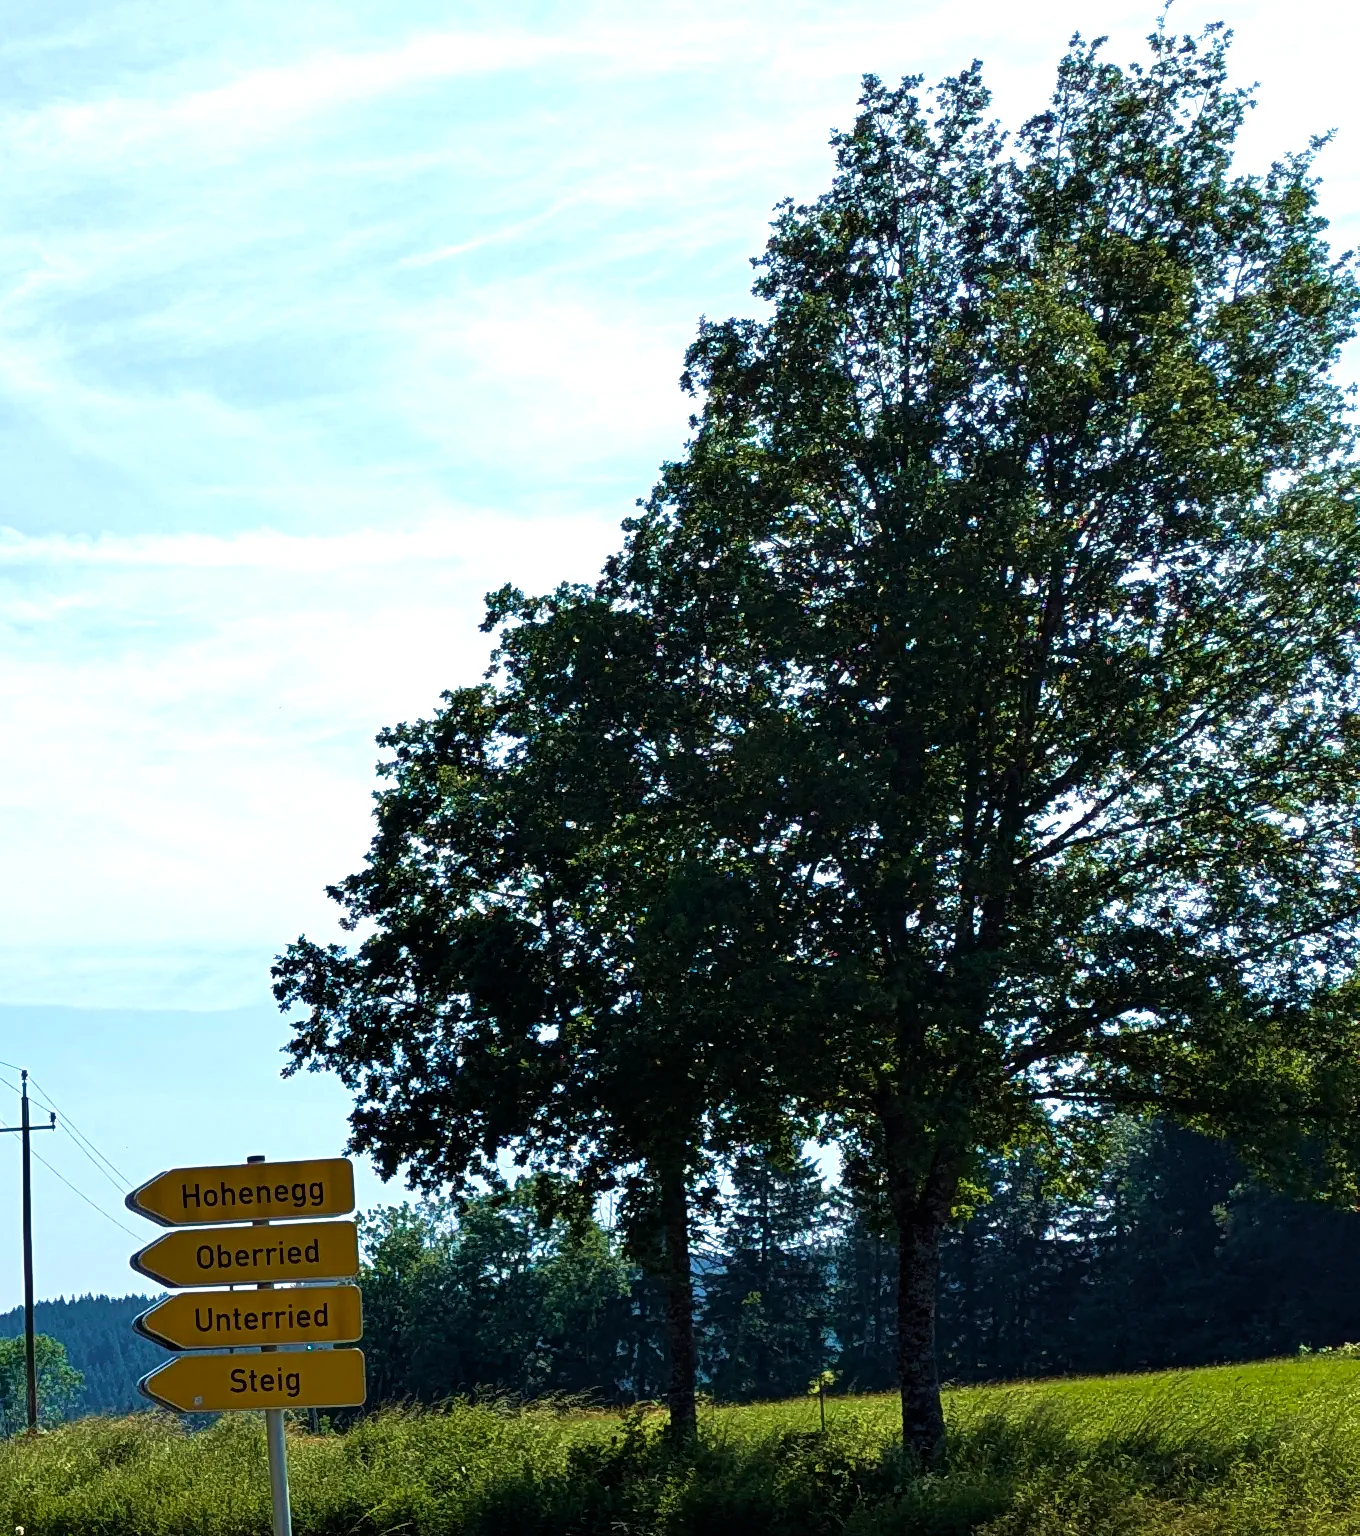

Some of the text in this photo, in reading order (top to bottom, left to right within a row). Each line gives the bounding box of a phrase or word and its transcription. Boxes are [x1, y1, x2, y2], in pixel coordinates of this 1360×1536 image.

[181, 1181, 324, 1208] Hohenegg
[196, 1239, 320, 1269] Oberried
[195, 1303, 328, 1332] Unterried
[230, 1367, 300, 1397] Steig
